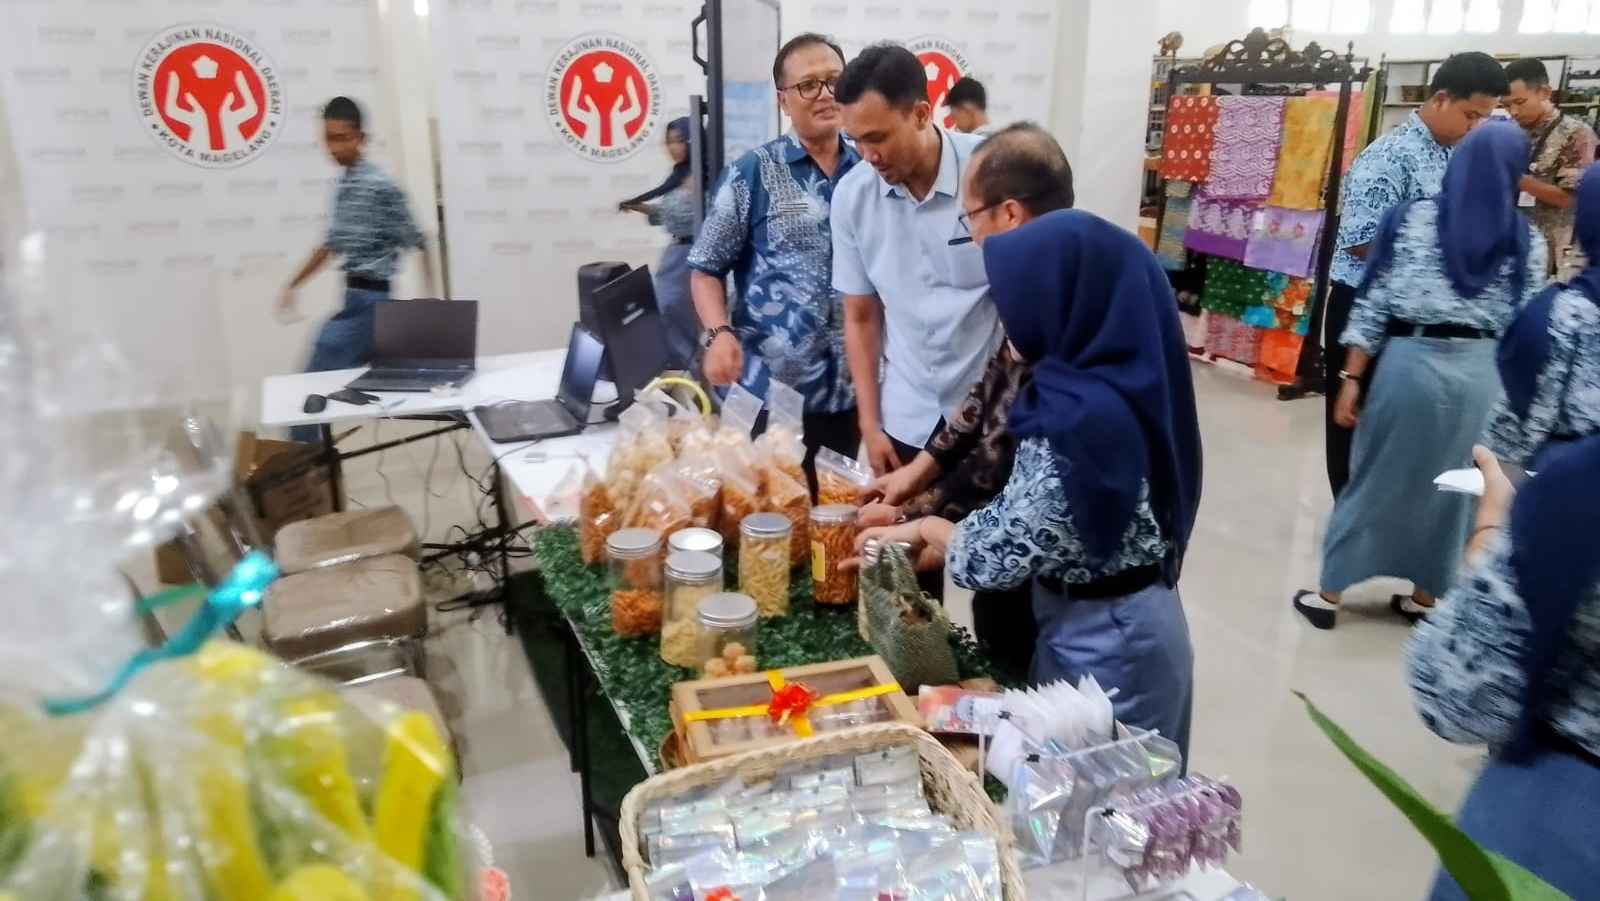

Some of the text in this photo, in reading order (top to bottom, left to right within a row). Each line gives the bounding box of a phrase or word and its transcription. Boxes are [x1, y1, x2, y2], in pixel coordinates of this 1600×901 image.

[137, 29, 281, 117] DEWAN KERAJINAN NASIONAL DAERAH
[546, 38, 660, 116] DEWAN KERAJINAN NASIONAL DAERAH
[158, 131, 272, 163] KOTA MAGELANG
[561, 128, 649, 158] KOTA MAGELANG
